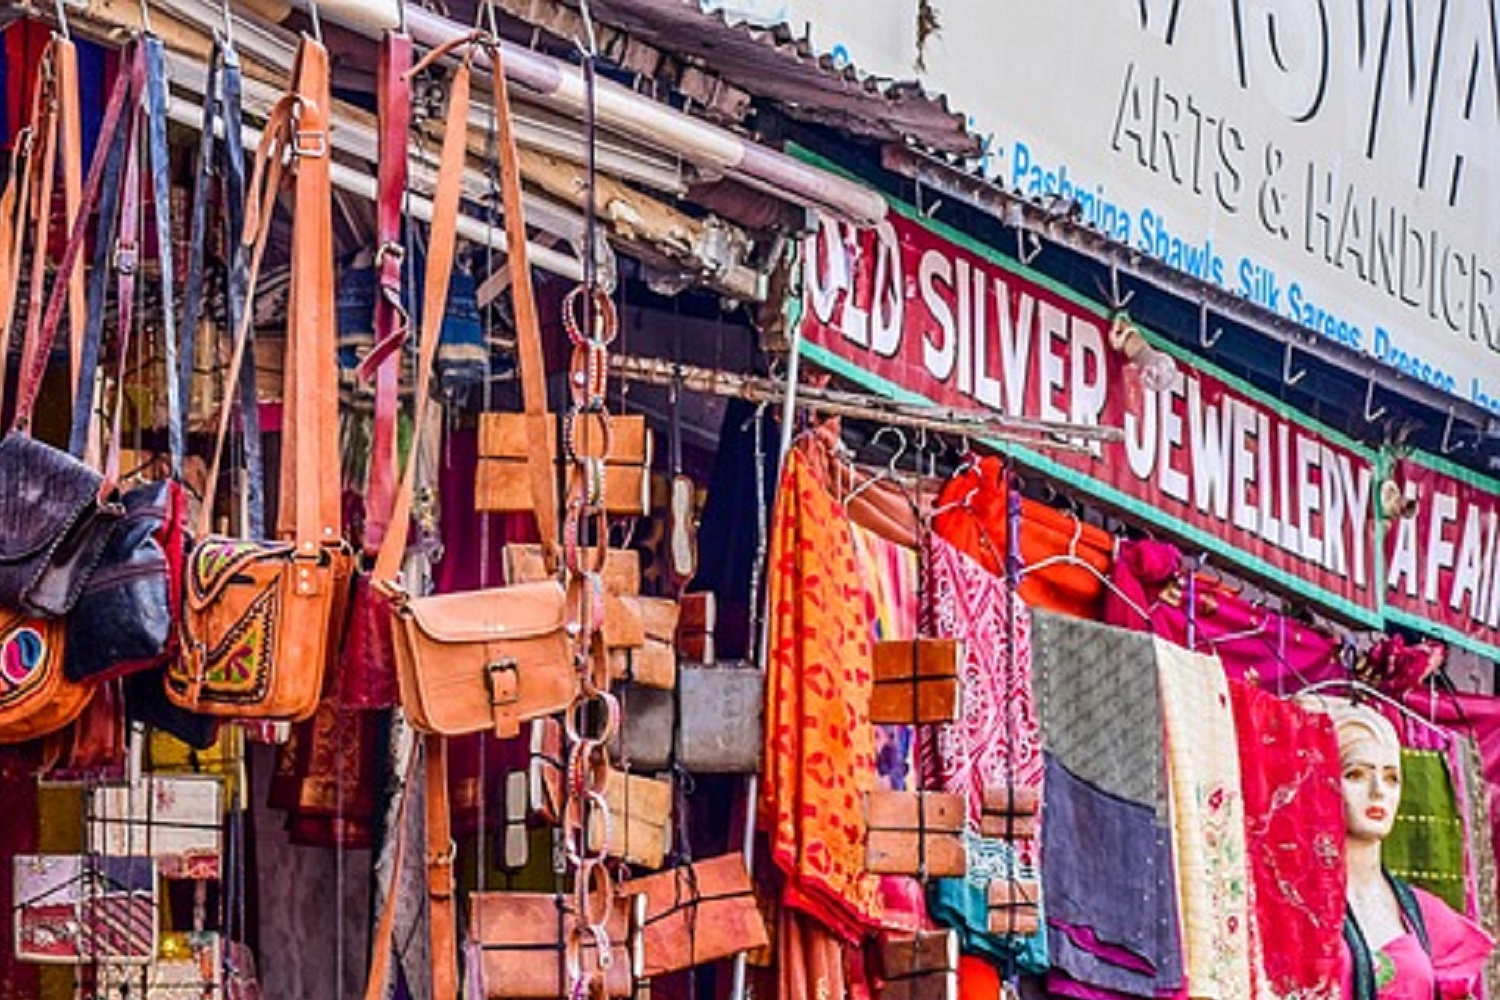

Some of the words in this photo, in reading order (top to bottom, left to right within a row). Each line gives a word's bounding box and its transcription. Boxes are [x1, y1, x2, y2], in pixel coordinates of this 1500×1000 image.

[1111, 62, 1246, 213] ARTS
[1257, 142, 1289, 241] &
[1238, 257, 1280, 309] Silk
[805, 213, 904, 358] OLD
[918, 248, 1107, 459] SILVER
[1123, 368, 1377, 589] JEWELLERY
